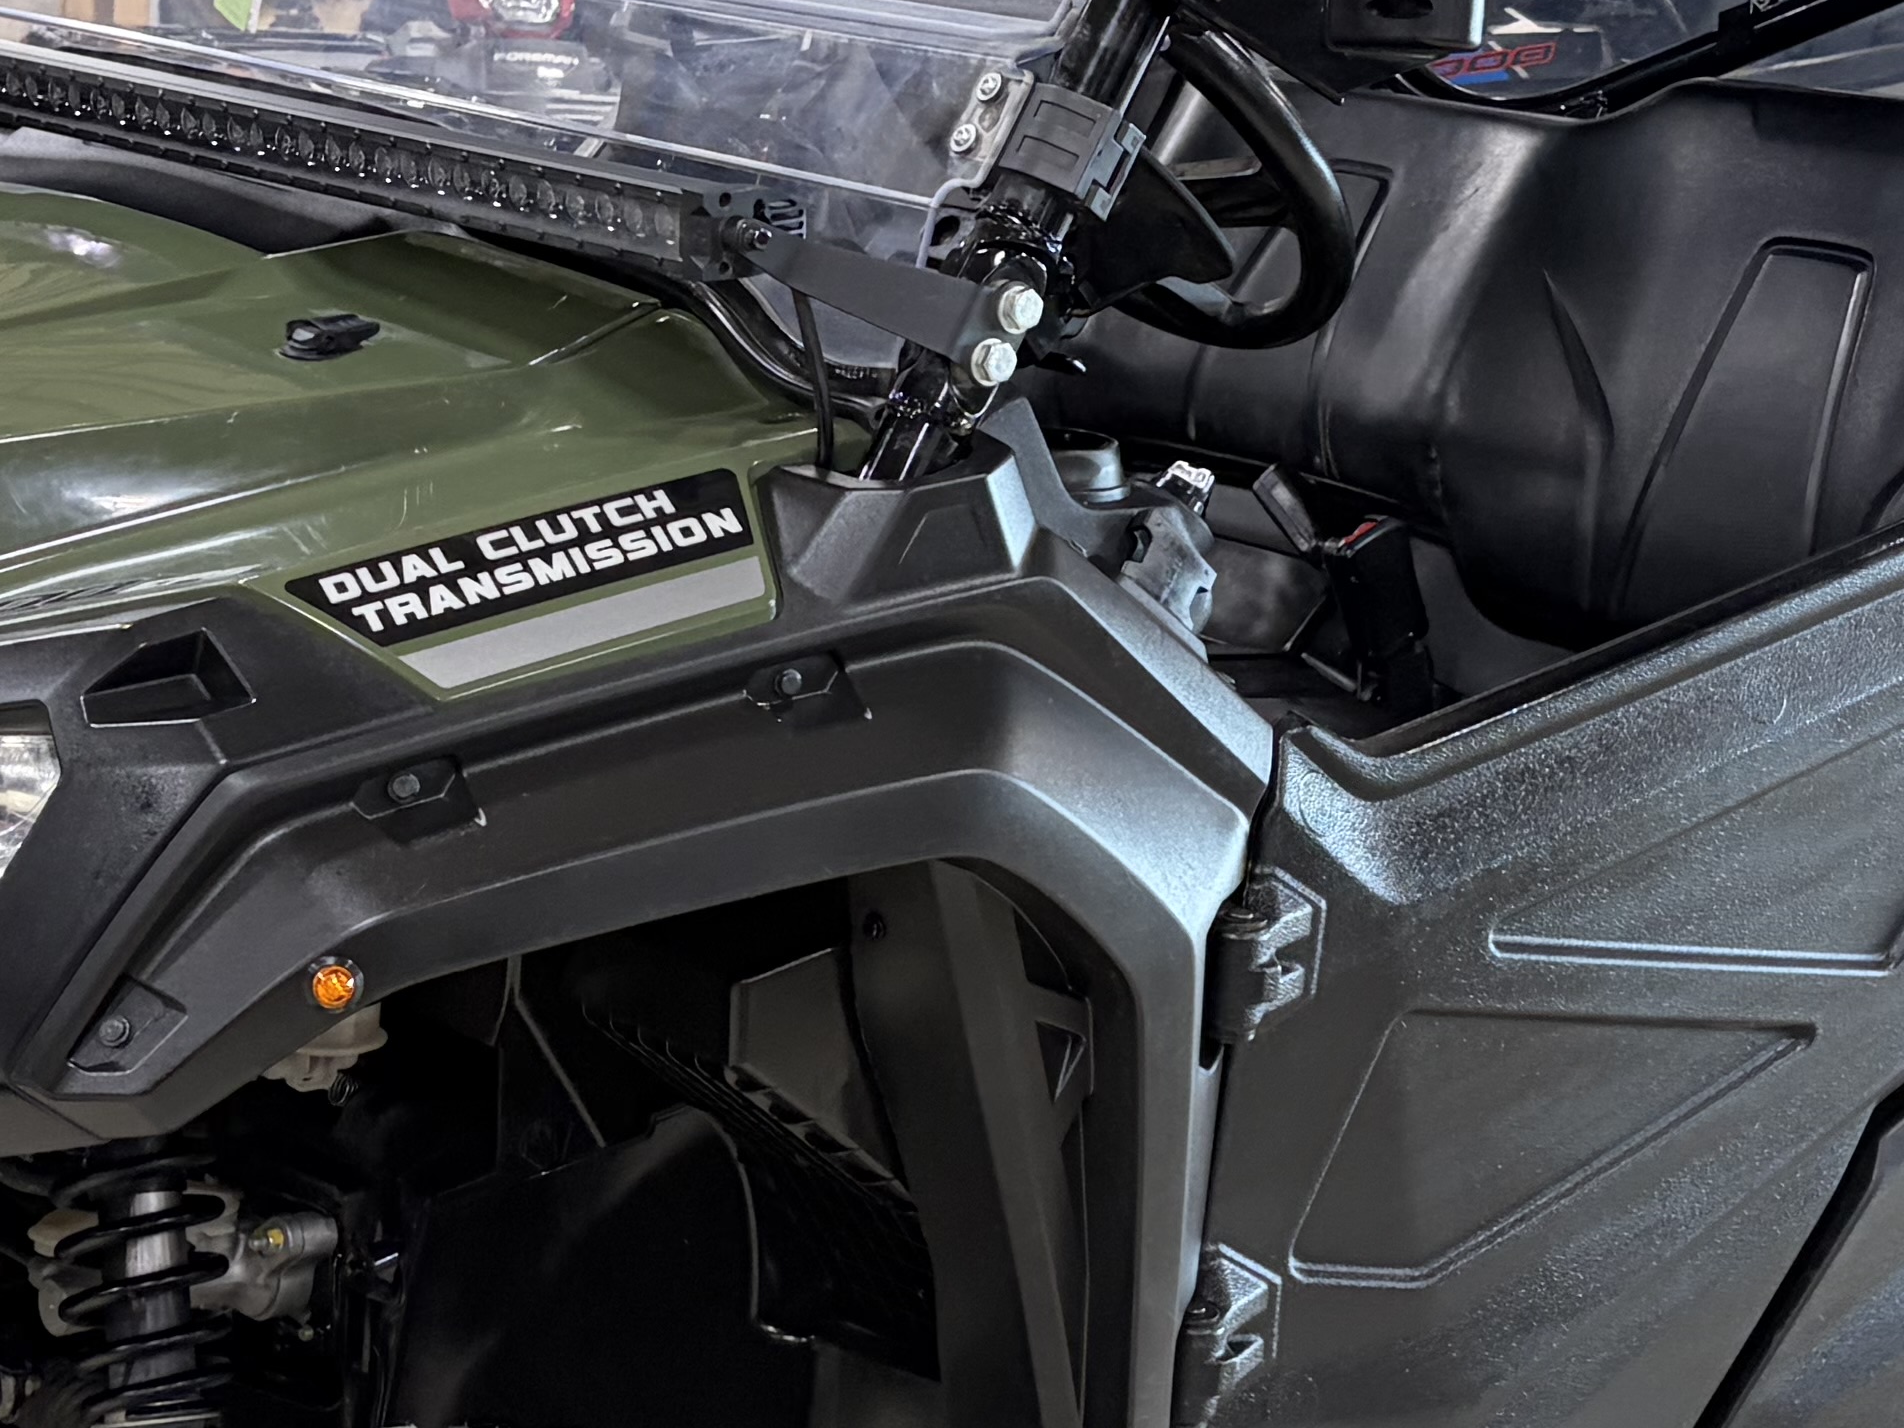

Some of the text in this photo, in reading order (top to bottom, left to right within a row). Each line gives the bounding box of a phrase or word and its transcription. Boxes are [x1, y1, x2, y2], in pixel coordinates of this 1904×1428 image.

[318, 488, 677, 605] DUAL CLUTCH
[351, 506, 745, 633] TRANSMISSION
